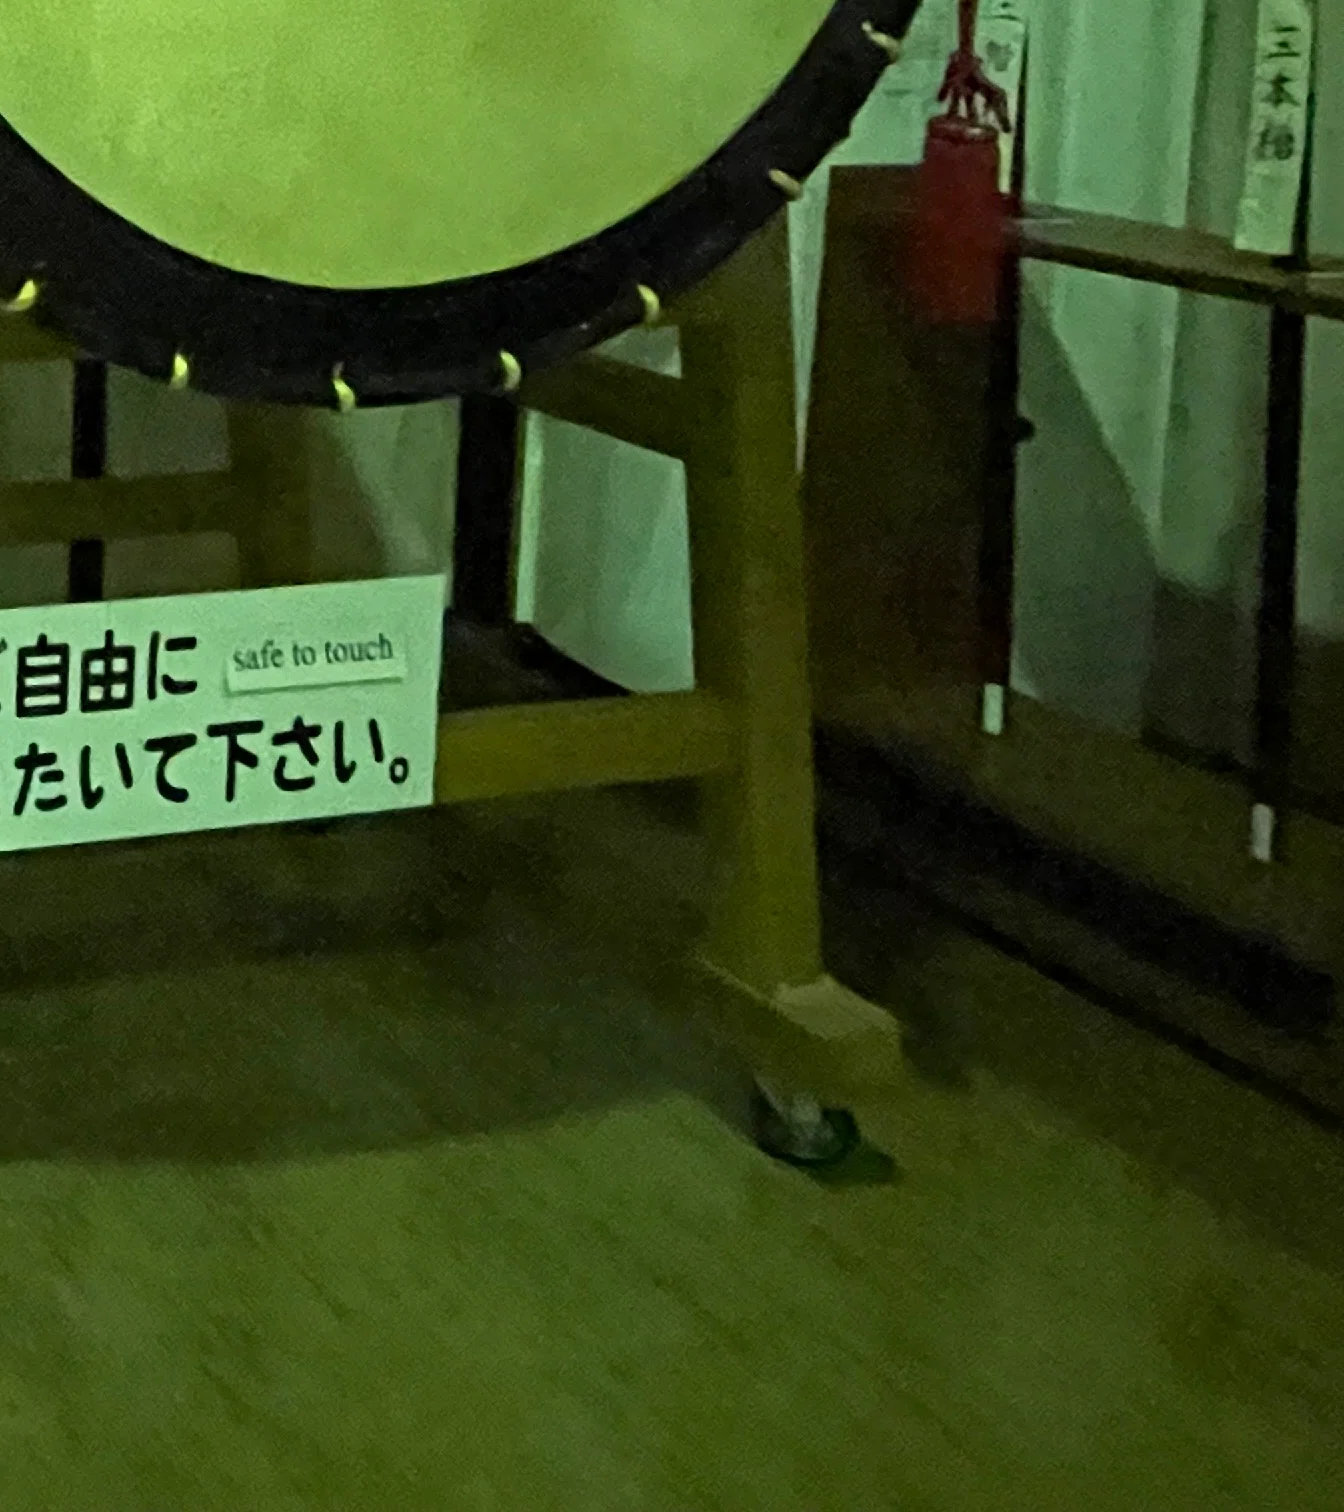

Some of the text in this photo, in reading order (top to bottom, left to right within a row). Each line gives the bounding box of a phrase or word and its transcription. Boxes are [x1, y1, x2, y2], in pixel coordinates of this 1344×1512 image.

[232, 633, 394, 672] safe to touch
